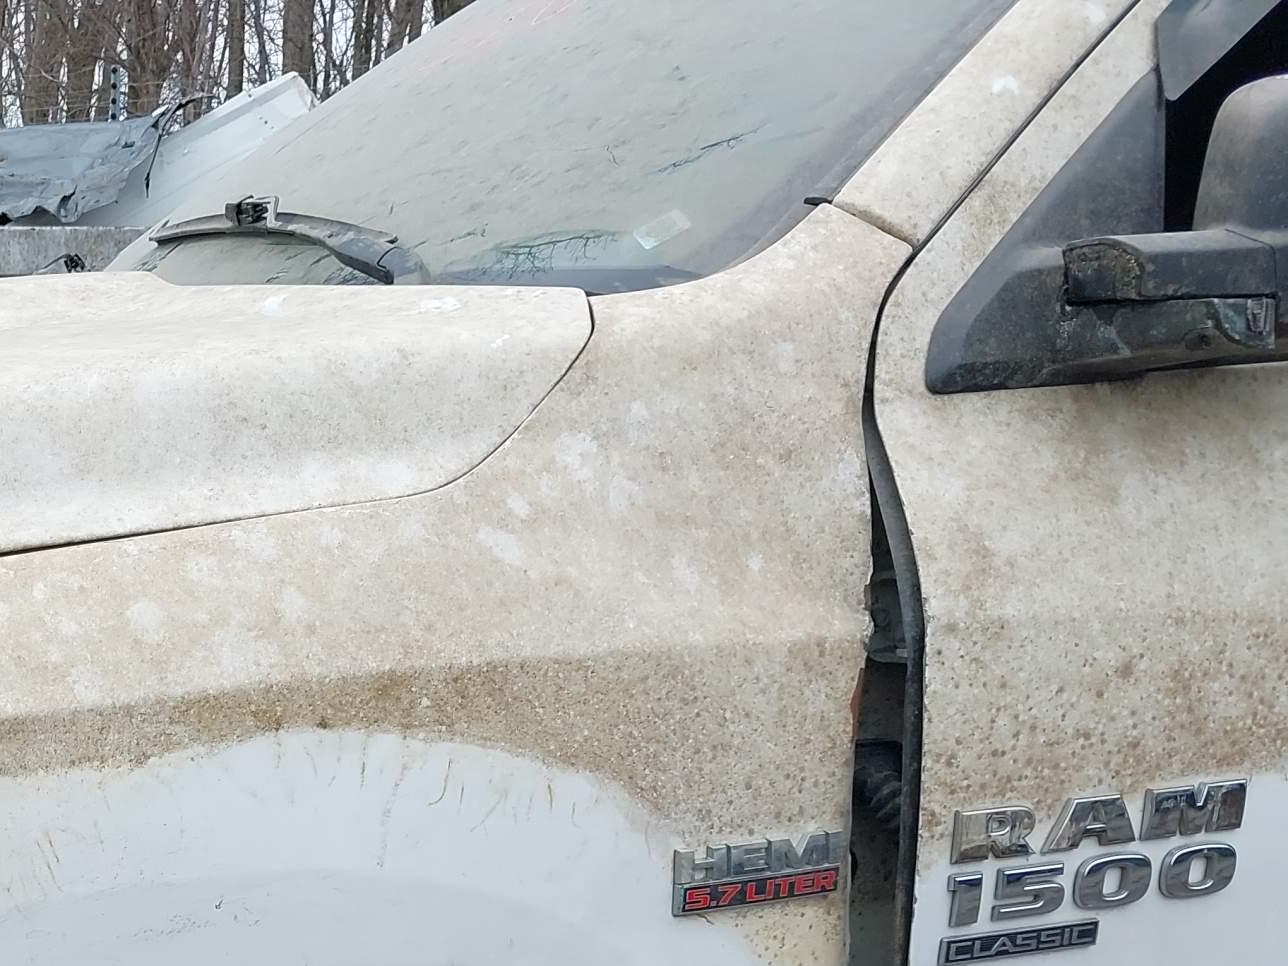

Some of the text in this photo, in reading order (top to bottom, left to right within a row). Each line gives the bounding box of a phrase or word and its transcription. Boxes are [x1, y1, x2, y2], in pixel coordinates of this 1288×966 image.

[950, 779, 1247, 864] RAM
[673, 831, 842, 885] HEMI
[947, 841, 1237, 928] 1500
[685, 869, 838, 910] 5.7 LITER
[948, 923, 1095, 962] CLASSIC
